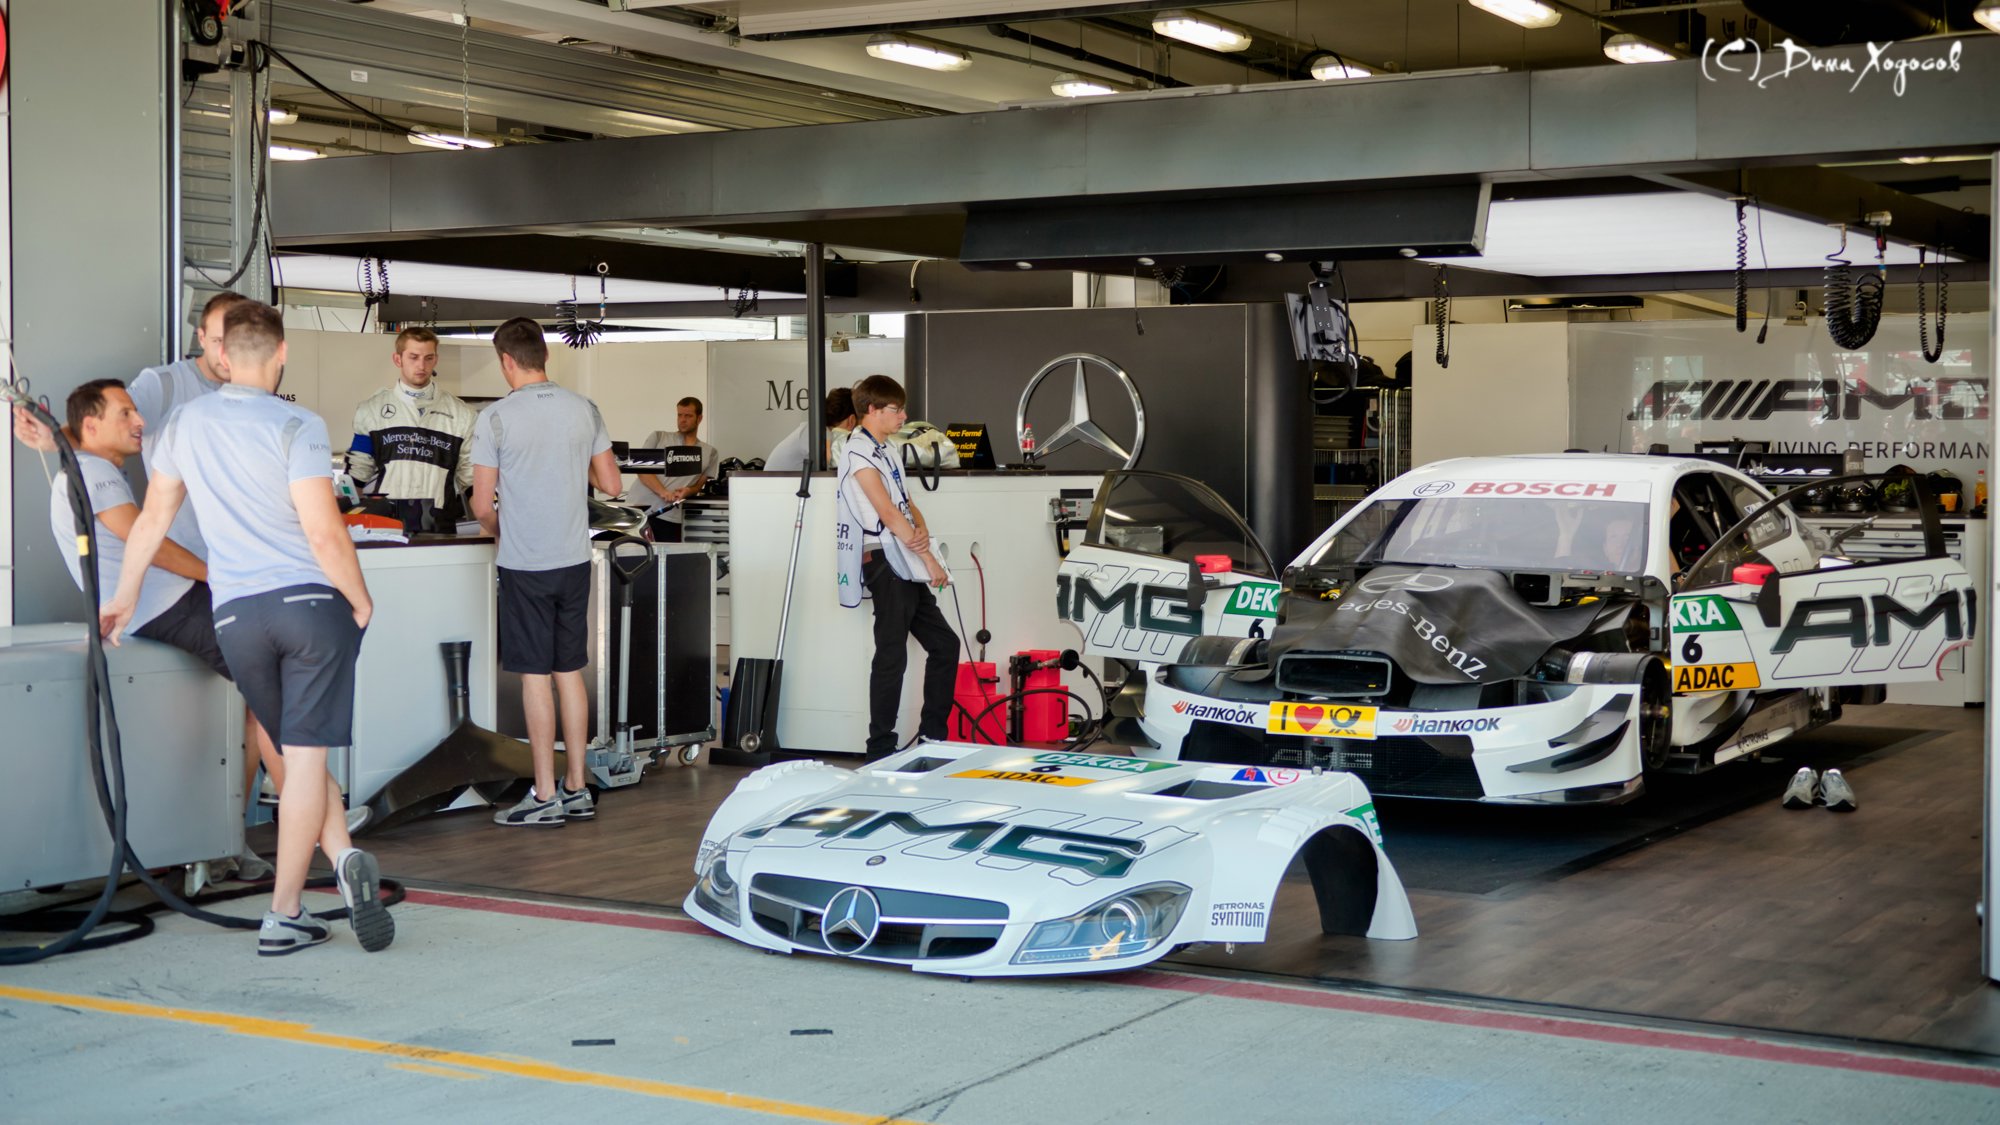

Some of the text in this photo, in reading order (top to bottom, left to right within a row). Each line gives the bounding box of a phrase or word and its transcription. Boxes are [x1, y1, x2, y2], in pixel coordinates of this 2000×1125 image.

[382, 431, 452, 451] Mercedes-Benz
[397, 443, 434, 458] Service
[1463, 481, 1617, 497] BOSCH
[1235, 586, 1278, 613] DEK
[1249, 618, 1264, 639] 6
[1681, 633, 1703, 664] 6
[1676, 664, 1735, 690] ADAC
[1030, 765, 1062, 773] 6
[1041, 753, 1150, 772] DEKRA
[980, 770, 1065, 784] ADAC
[737, 806, 1147, 878] AMG
[1212, 901, 1265, 911] PETRONAS
[1211, 911, 1265, 928] SYNTIUM
